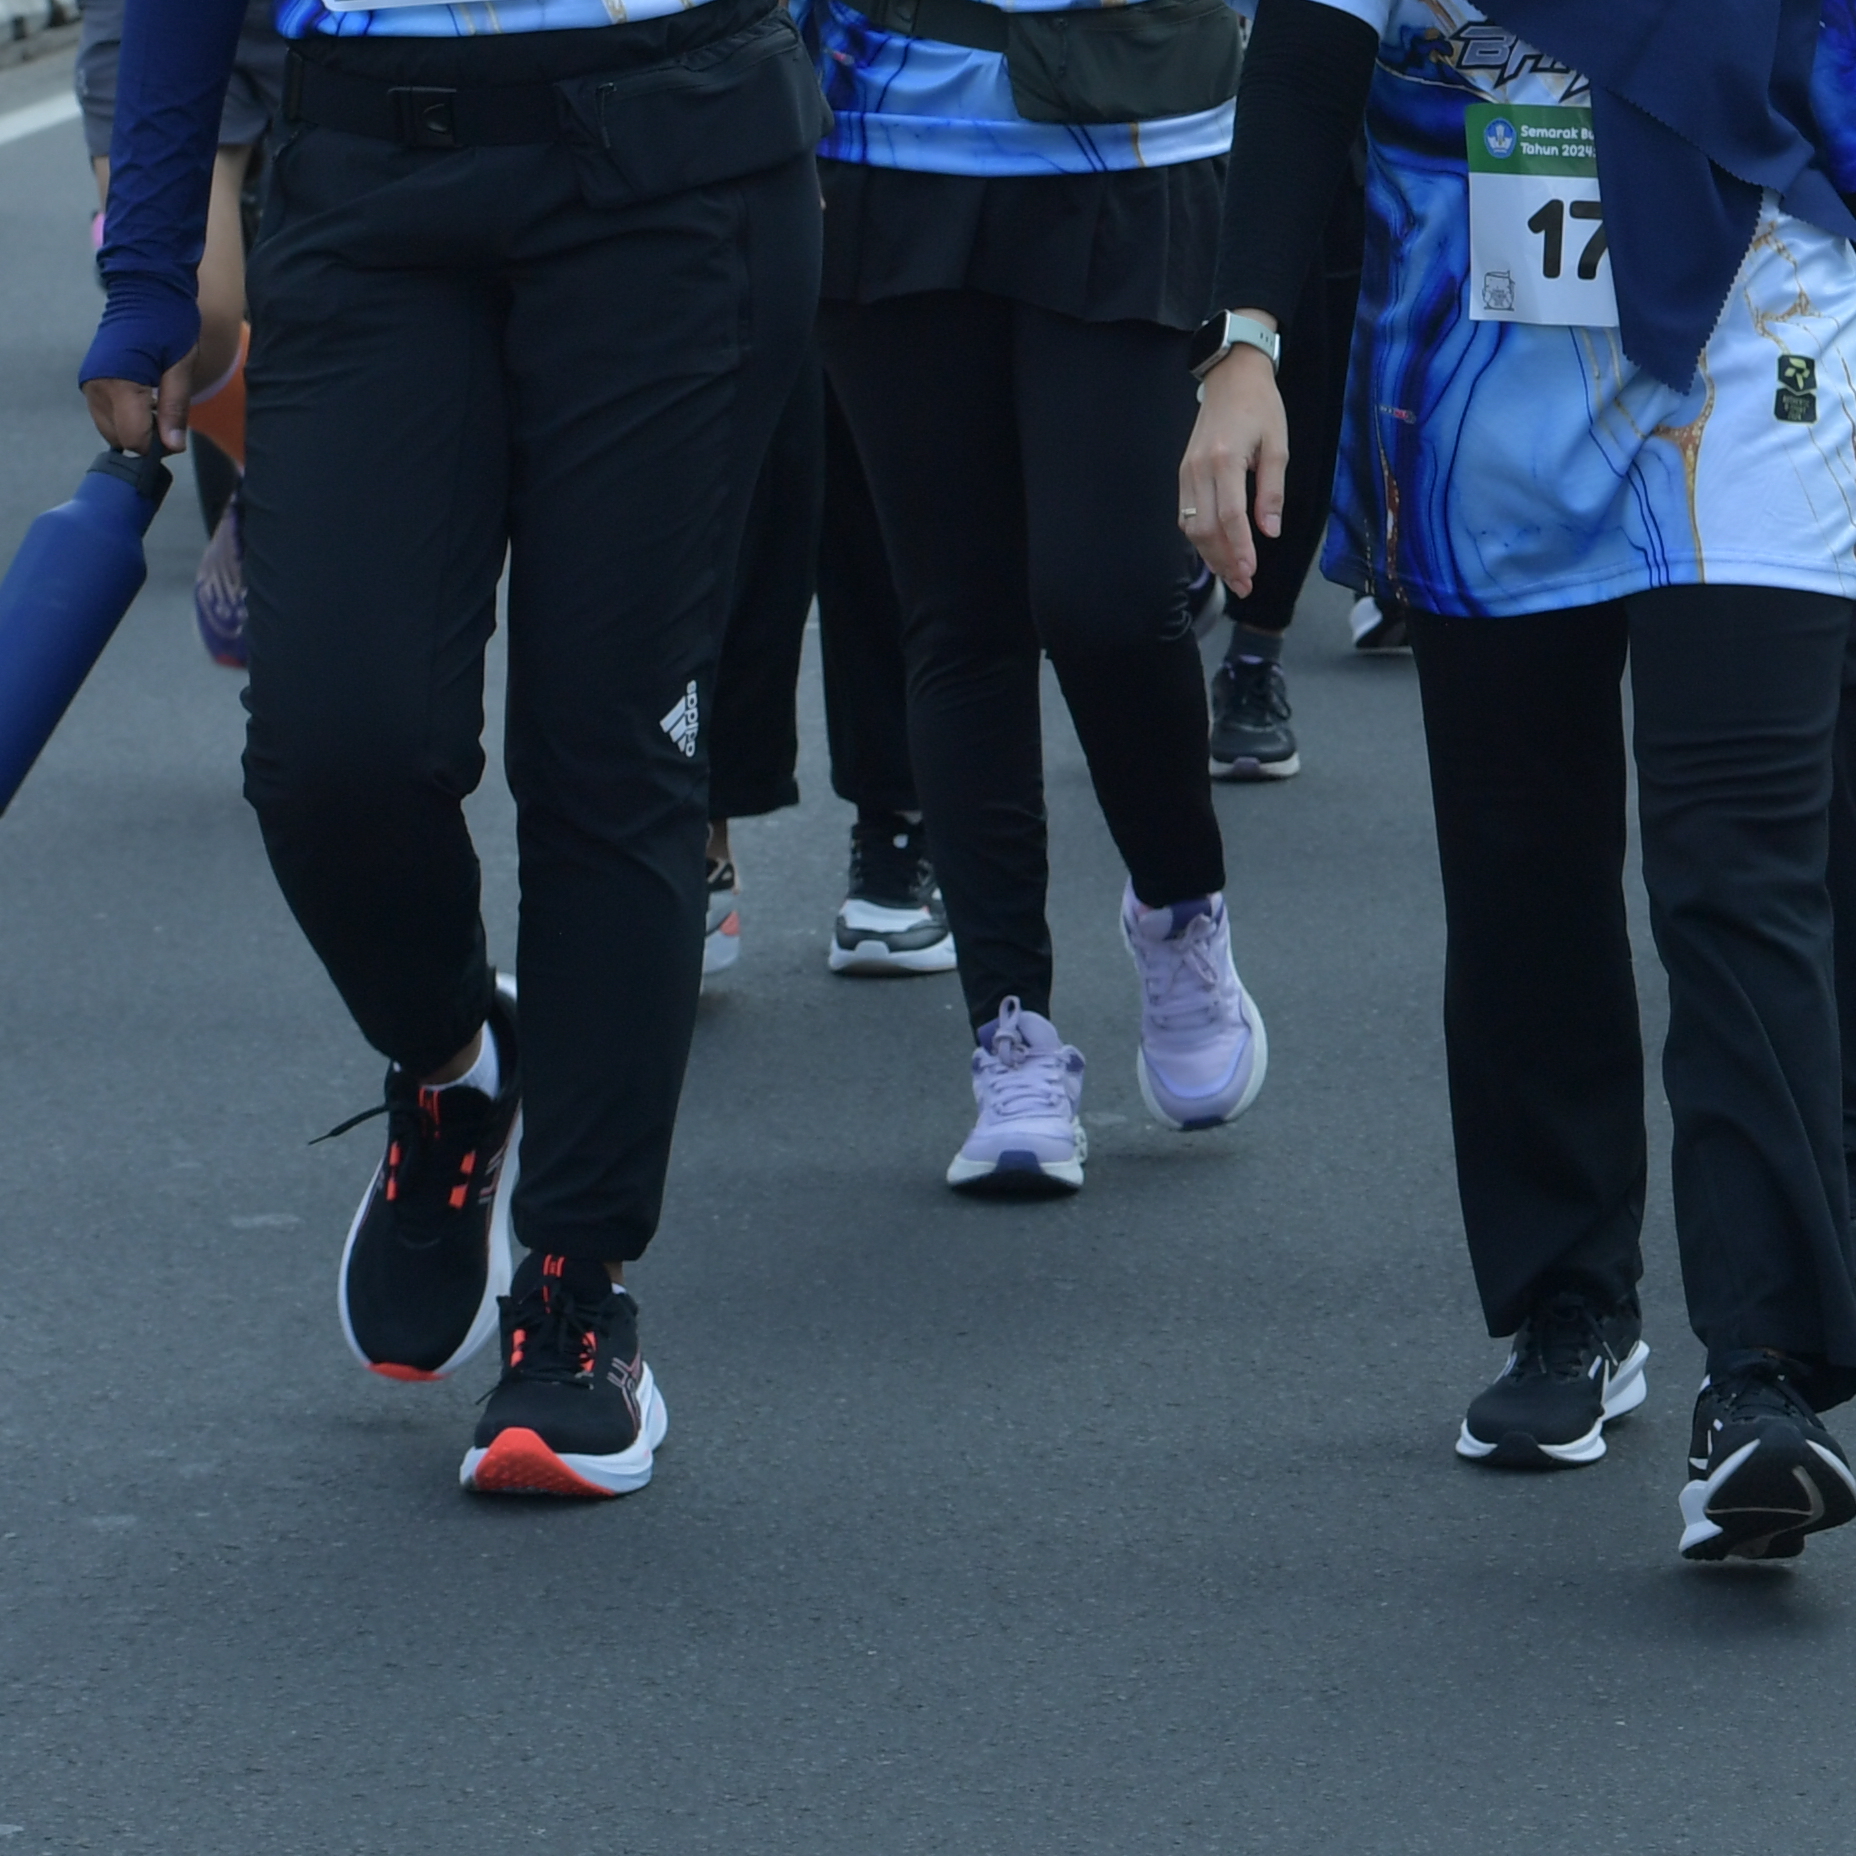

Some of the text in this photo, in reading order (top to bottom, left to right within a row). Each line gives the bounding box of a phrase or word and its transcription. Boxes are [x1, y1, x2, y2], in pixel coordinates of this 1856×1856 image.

[1520, 124, 1579, 140] Semarak
[1520, 142, 1559, 157] Tahun
[684, 679, 699, 759] adidas
